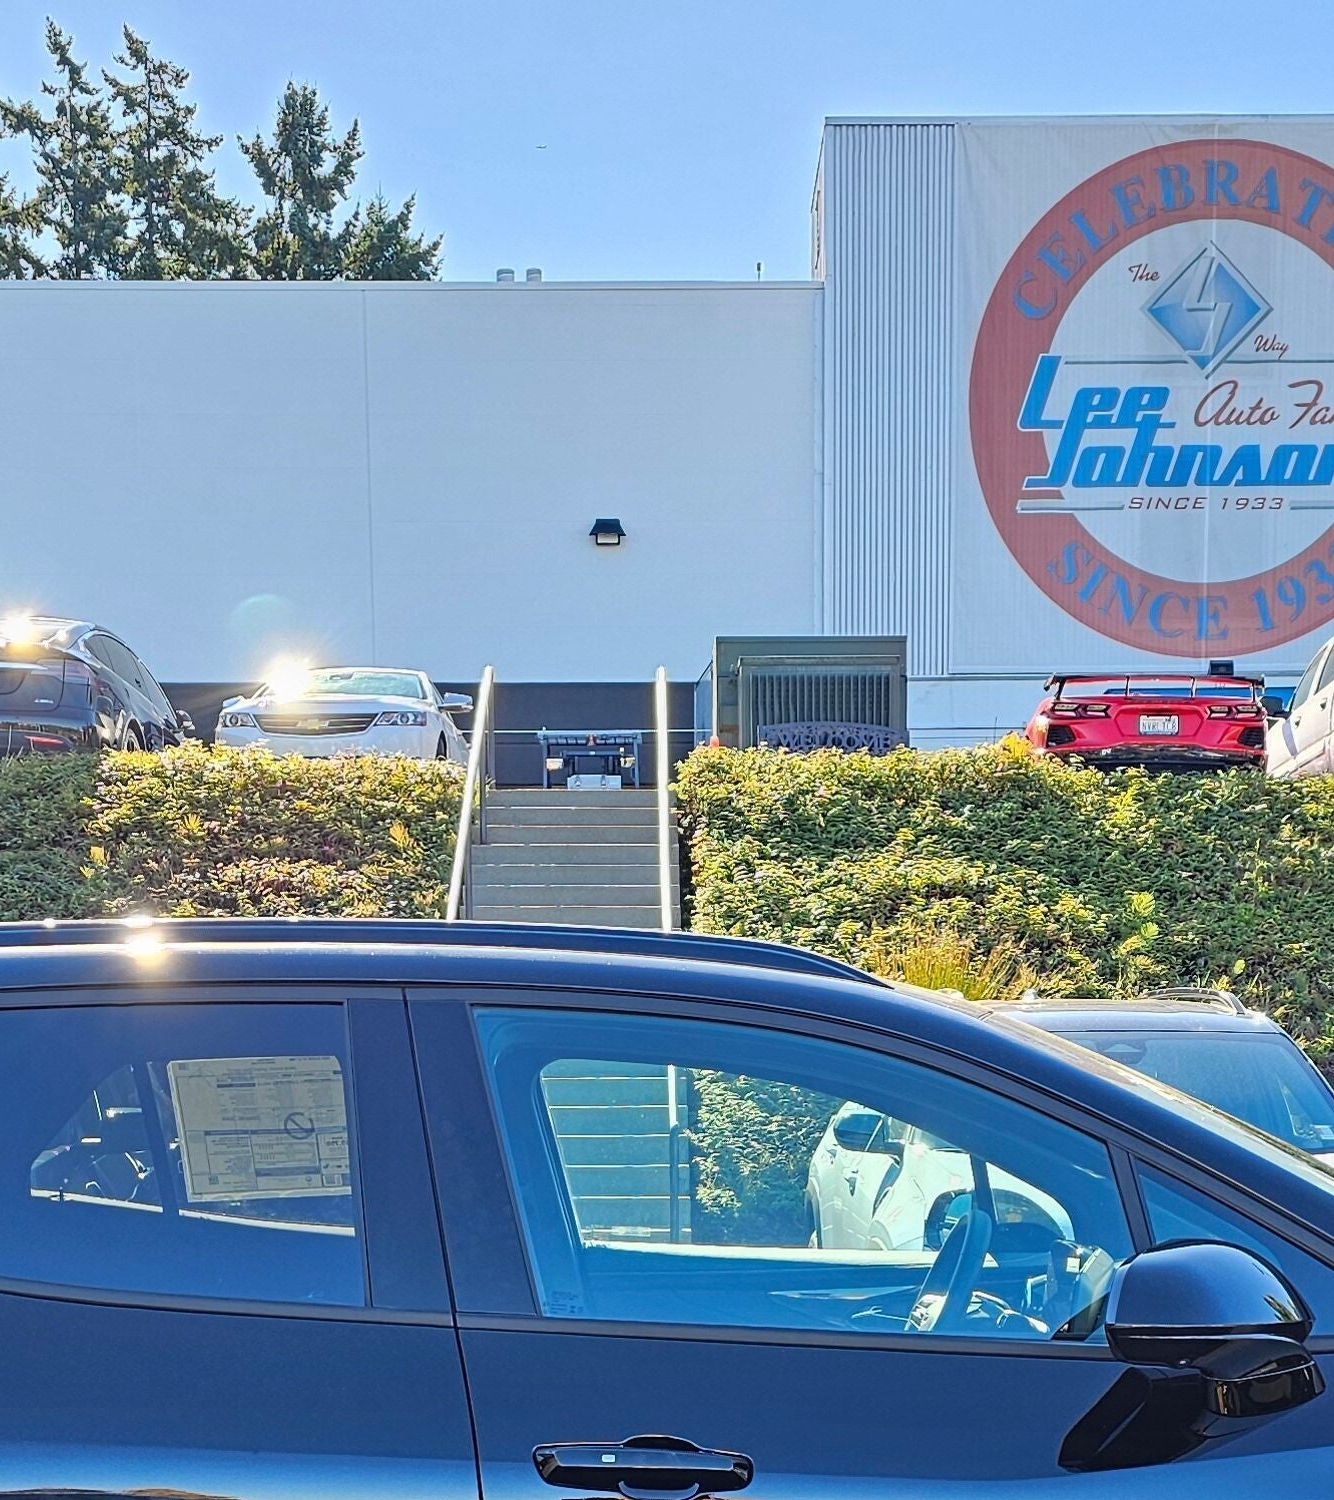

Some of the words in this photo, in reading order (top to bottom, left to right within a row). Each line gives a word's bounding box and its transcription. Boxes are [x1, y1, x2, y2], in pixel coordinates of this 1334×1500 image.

[1128, 263, 1160, 285] The
[1254, 334, 1290, 359] Way
[1019, 354, 1176, 430] Lee
[1193, 380, 1279, 429] Auto
[1128, 497, 1206, 510] SINCE
[1221, 497, 1285, 510] 1933
[1046, 540, 1229, 641] SINCE
